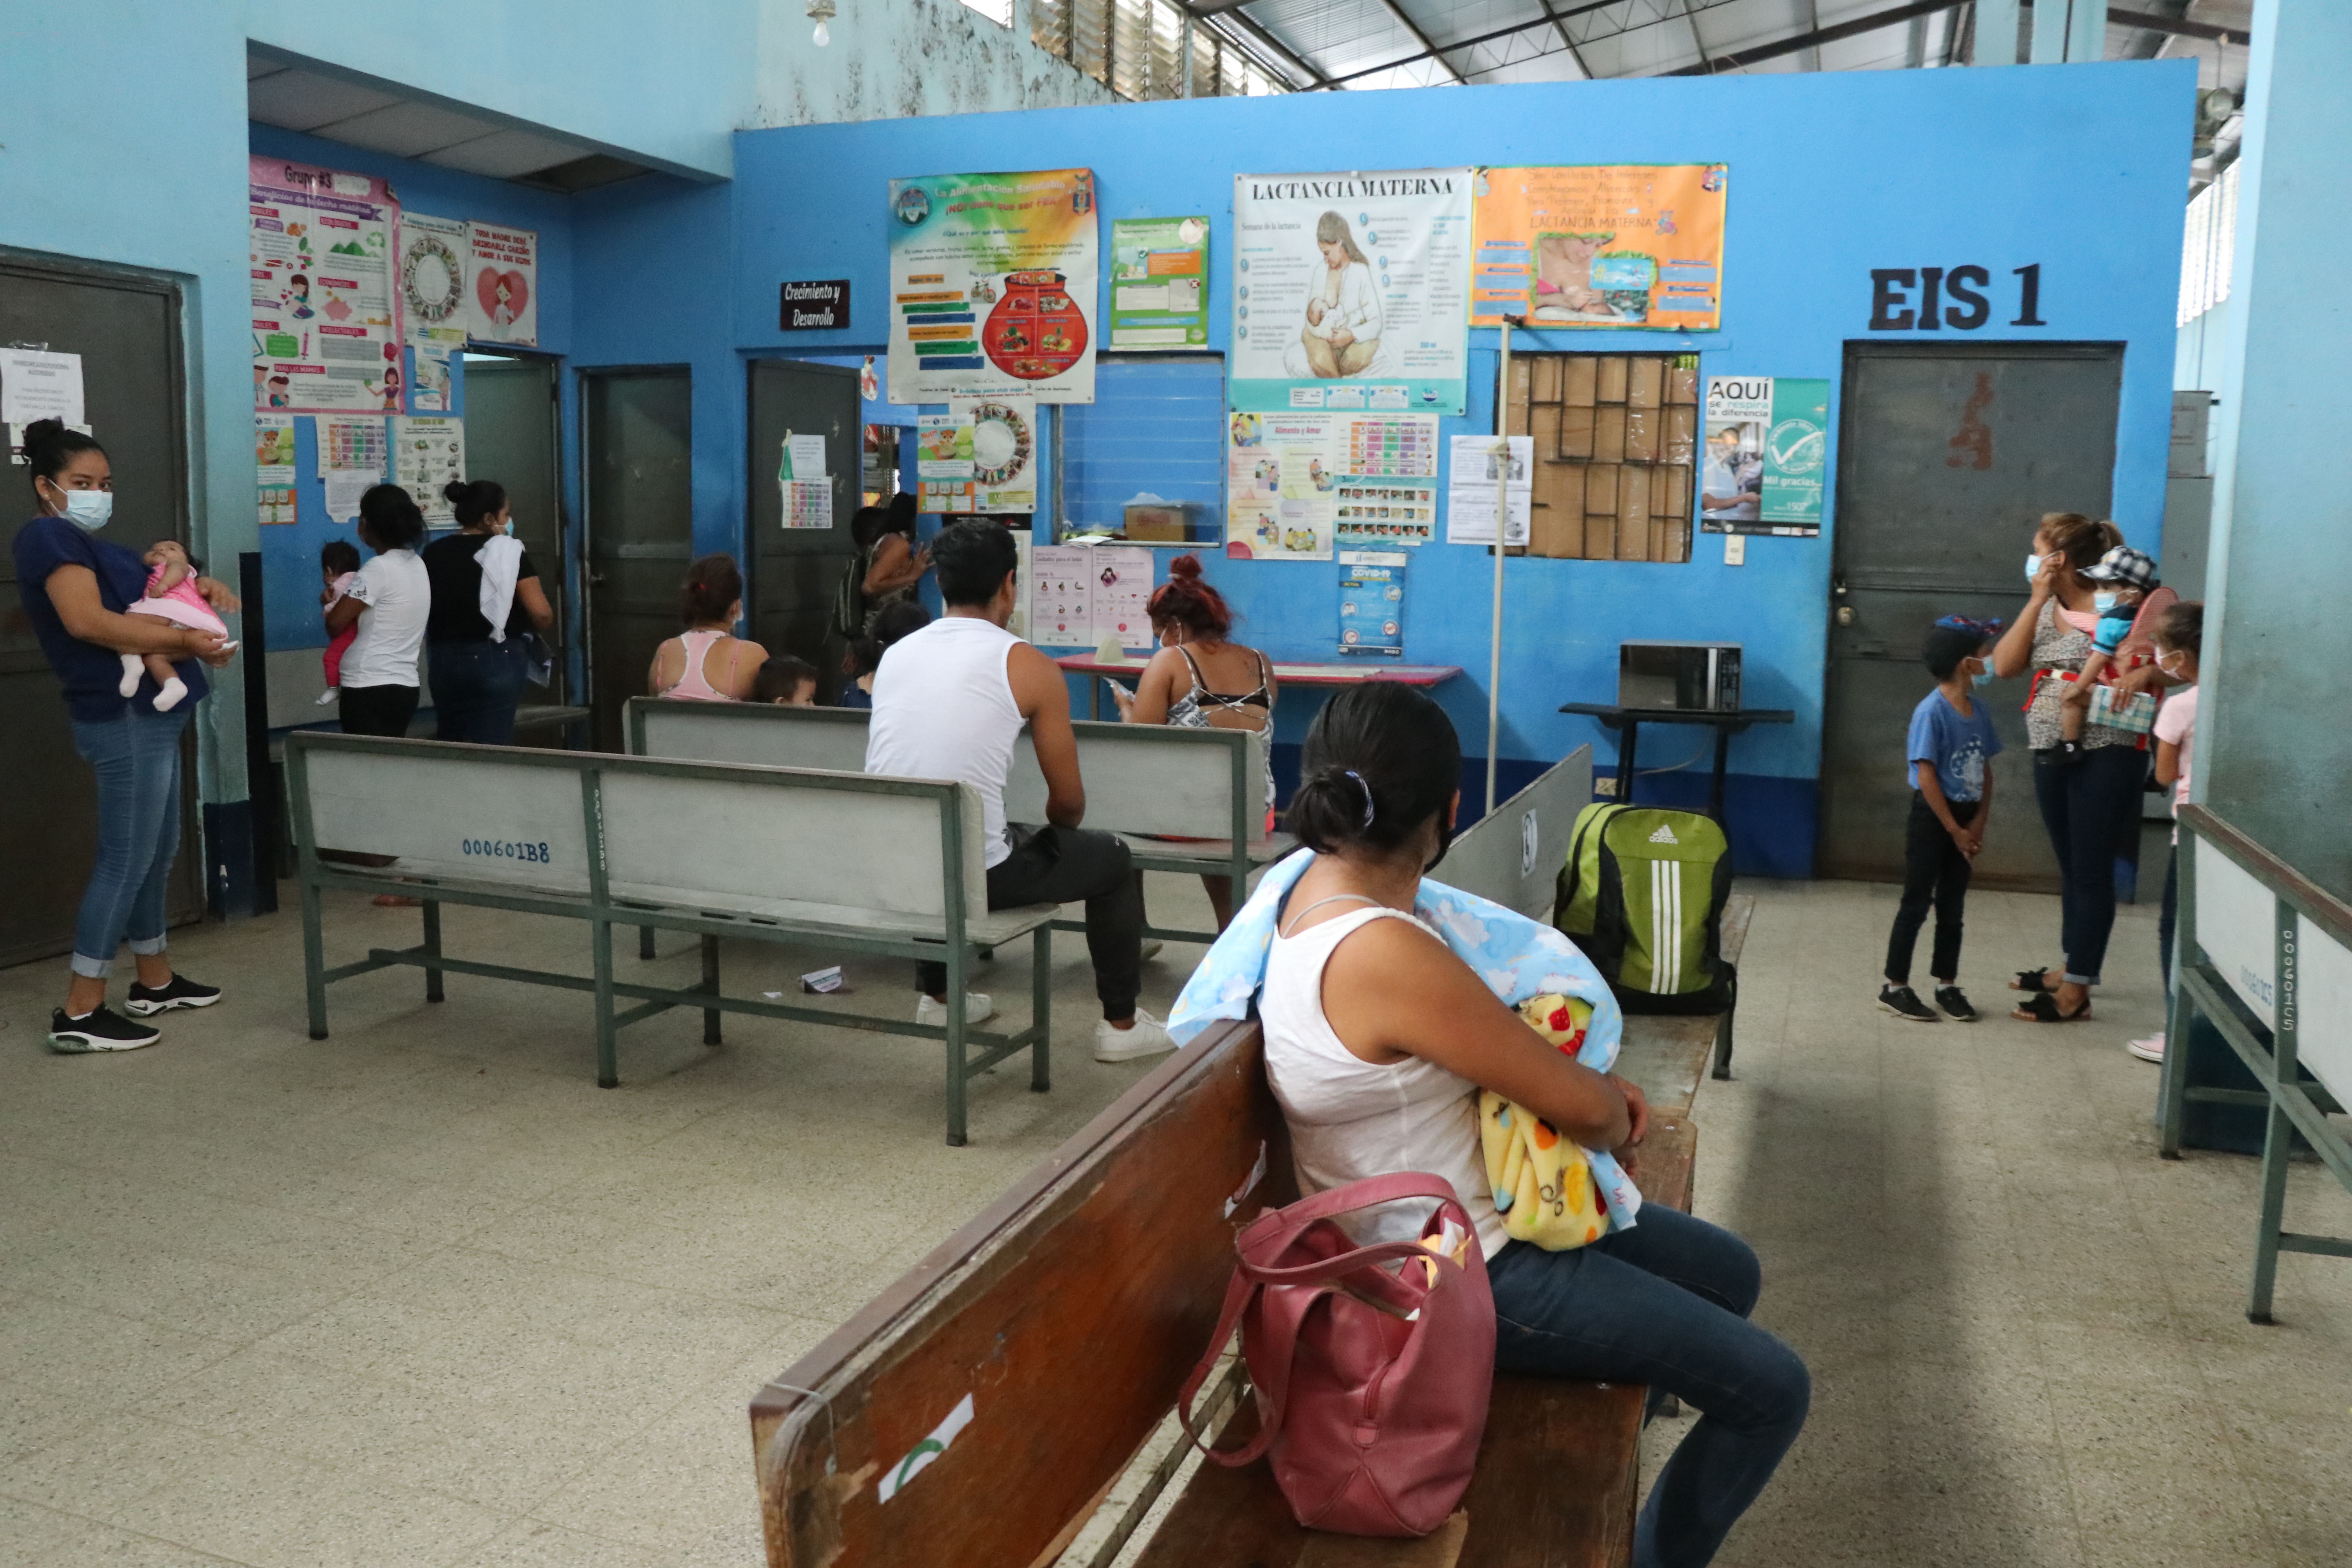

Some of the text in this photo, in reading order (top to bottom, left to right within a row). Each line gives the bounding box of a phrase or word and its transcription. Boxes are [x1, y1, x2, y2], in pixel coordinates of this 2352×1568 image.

[1253, 178, 1454, 200] LACTANCIA MATERNA
[1530, 216, 1595, 228] LACTANCIA
[785, 282, 840, 304] Crecimiento y
[1869, 263, 2047, 330] EIS 1
[793, 307, 835, 326] Desarrollo
[1708, 377, 1769, 399] AQUÍ
[1721, 408, 1769, 417] diferencia
[1728, 401, 1769, 410] respira
[1764, 476, 1779, 485] Mil
[1351, 568, 1391, 578] COVID-19
[1649, 836, 1679, 844] adidas
[463, 838, 550, 863] 000601B8
